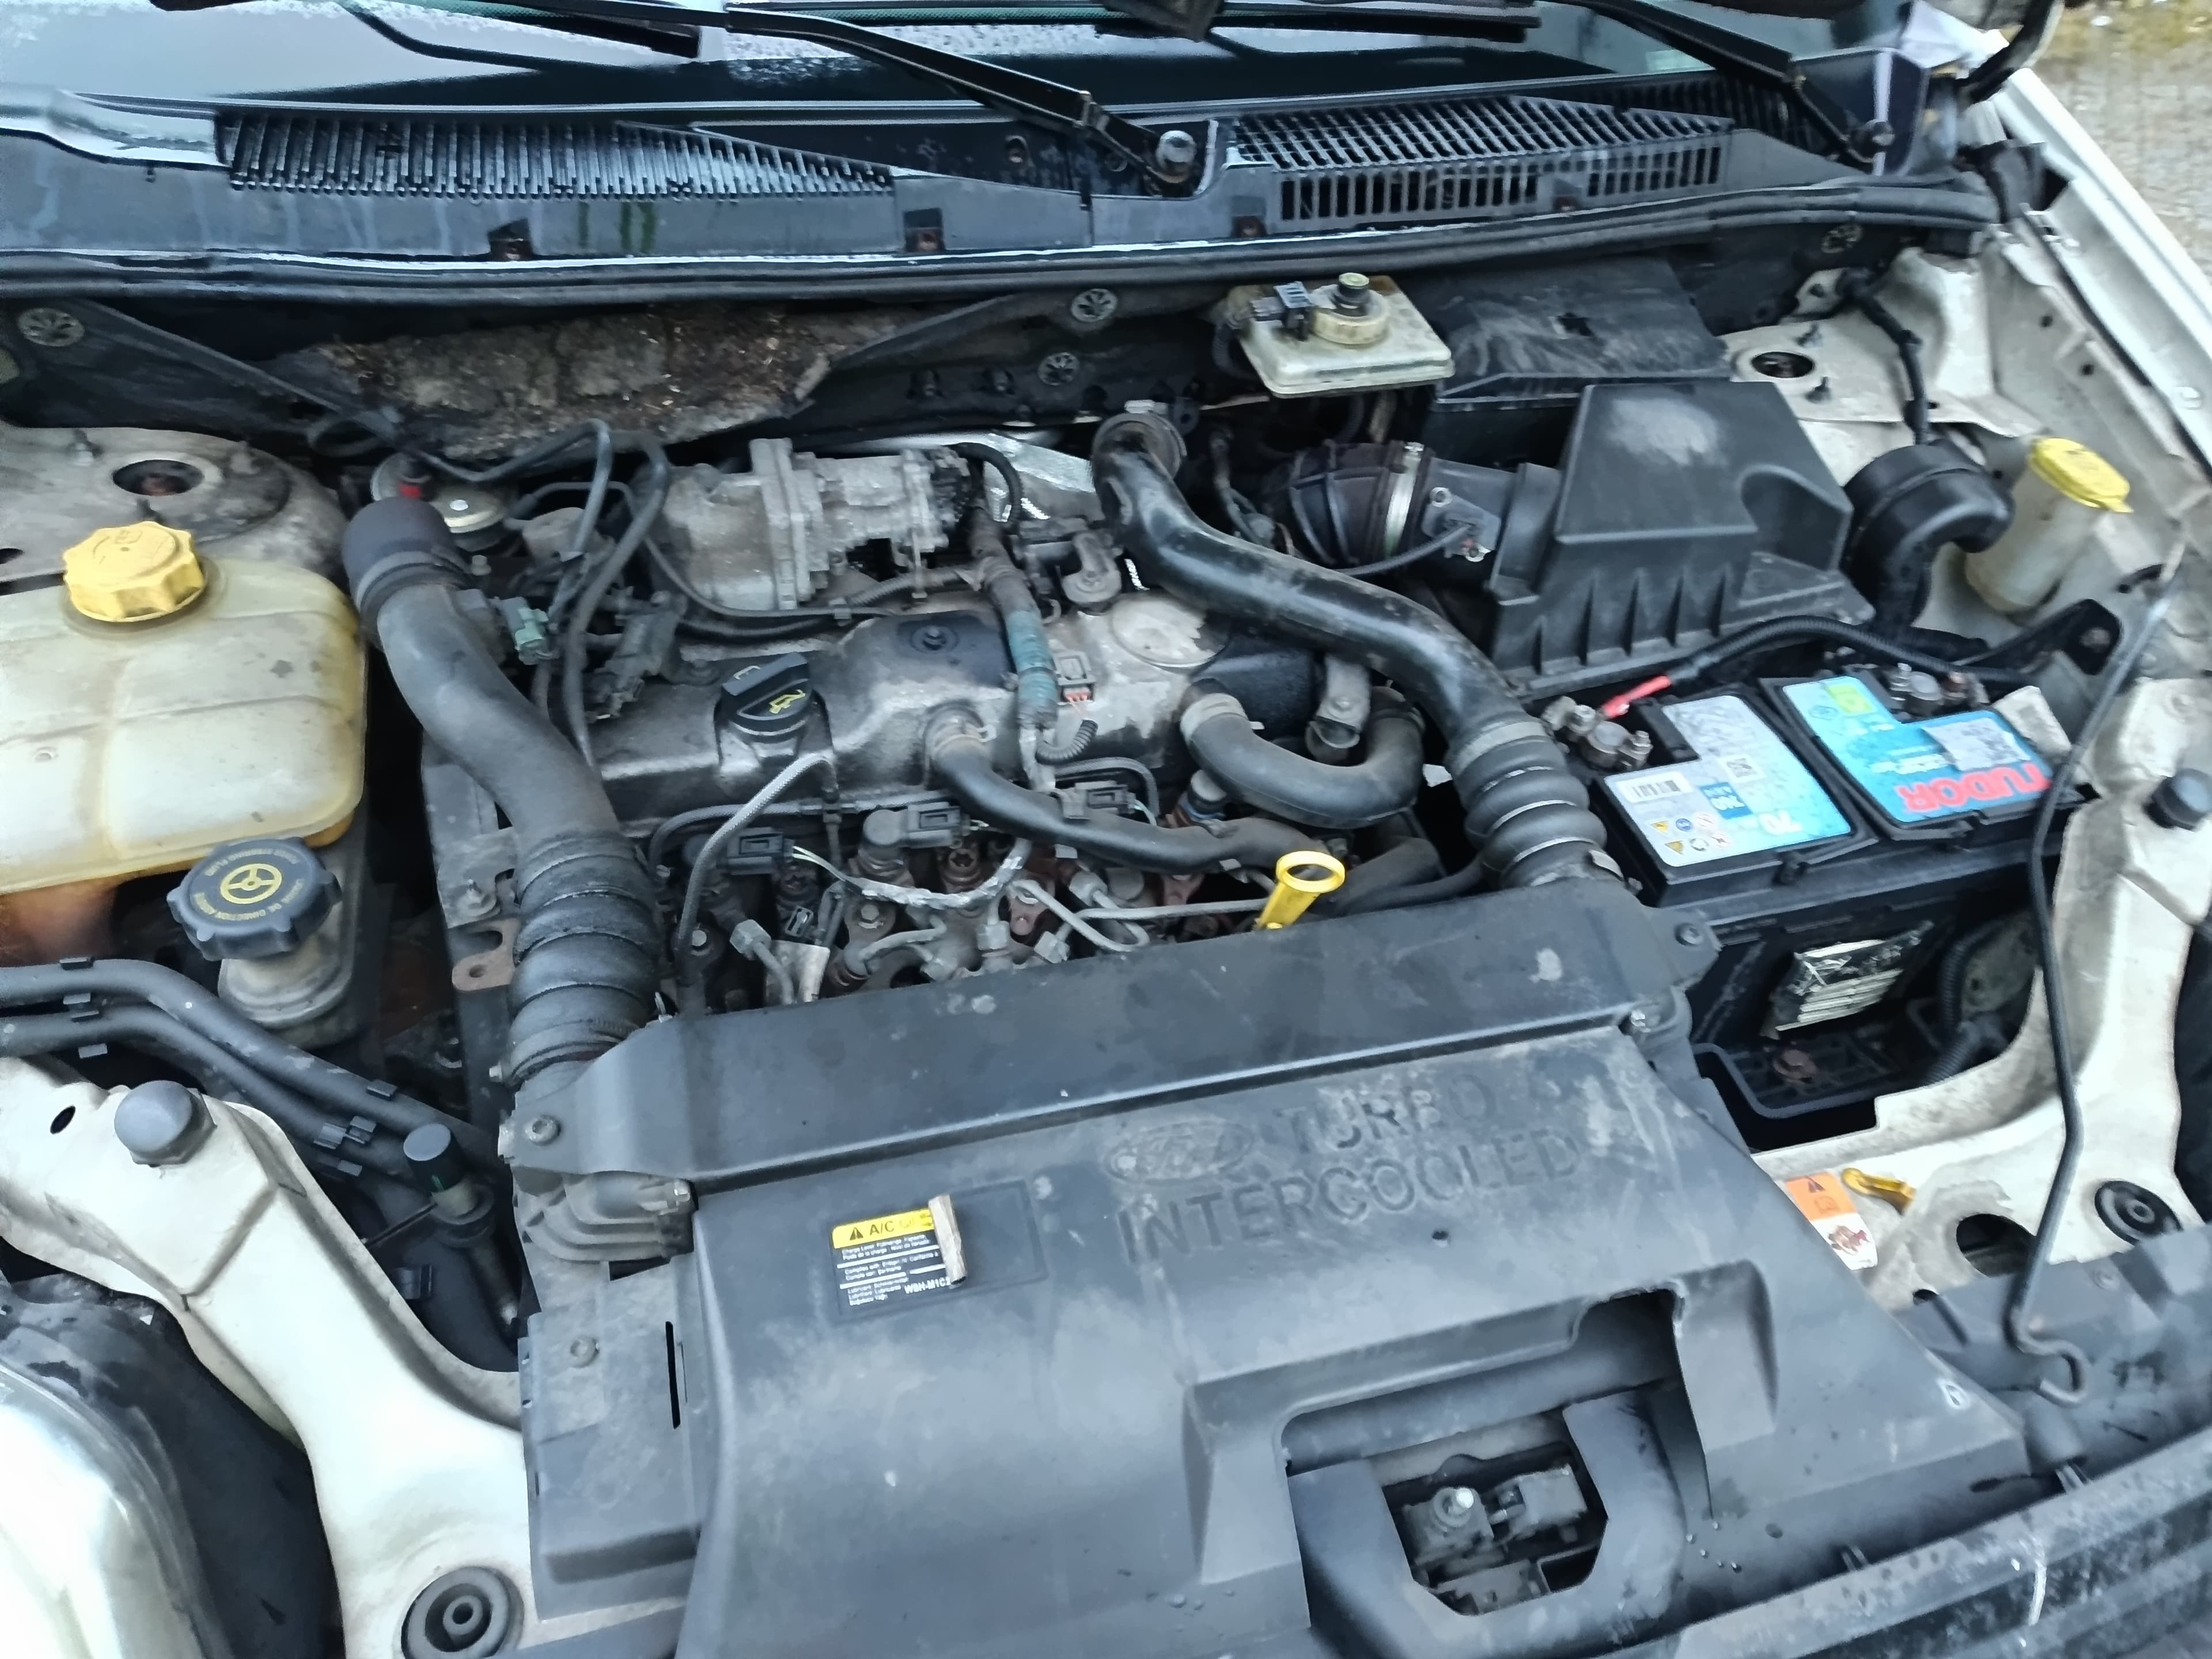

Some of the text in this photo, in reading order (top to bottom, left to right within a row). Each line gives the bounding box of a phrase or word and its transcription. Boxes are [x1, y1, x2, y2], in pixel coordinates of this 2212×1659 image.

[1895, 763, 2052, 813] TUDOR
[1116, 1129, 1581, 1263] INTERCOOLED
[869, 1221, 895, 1236] A/C
